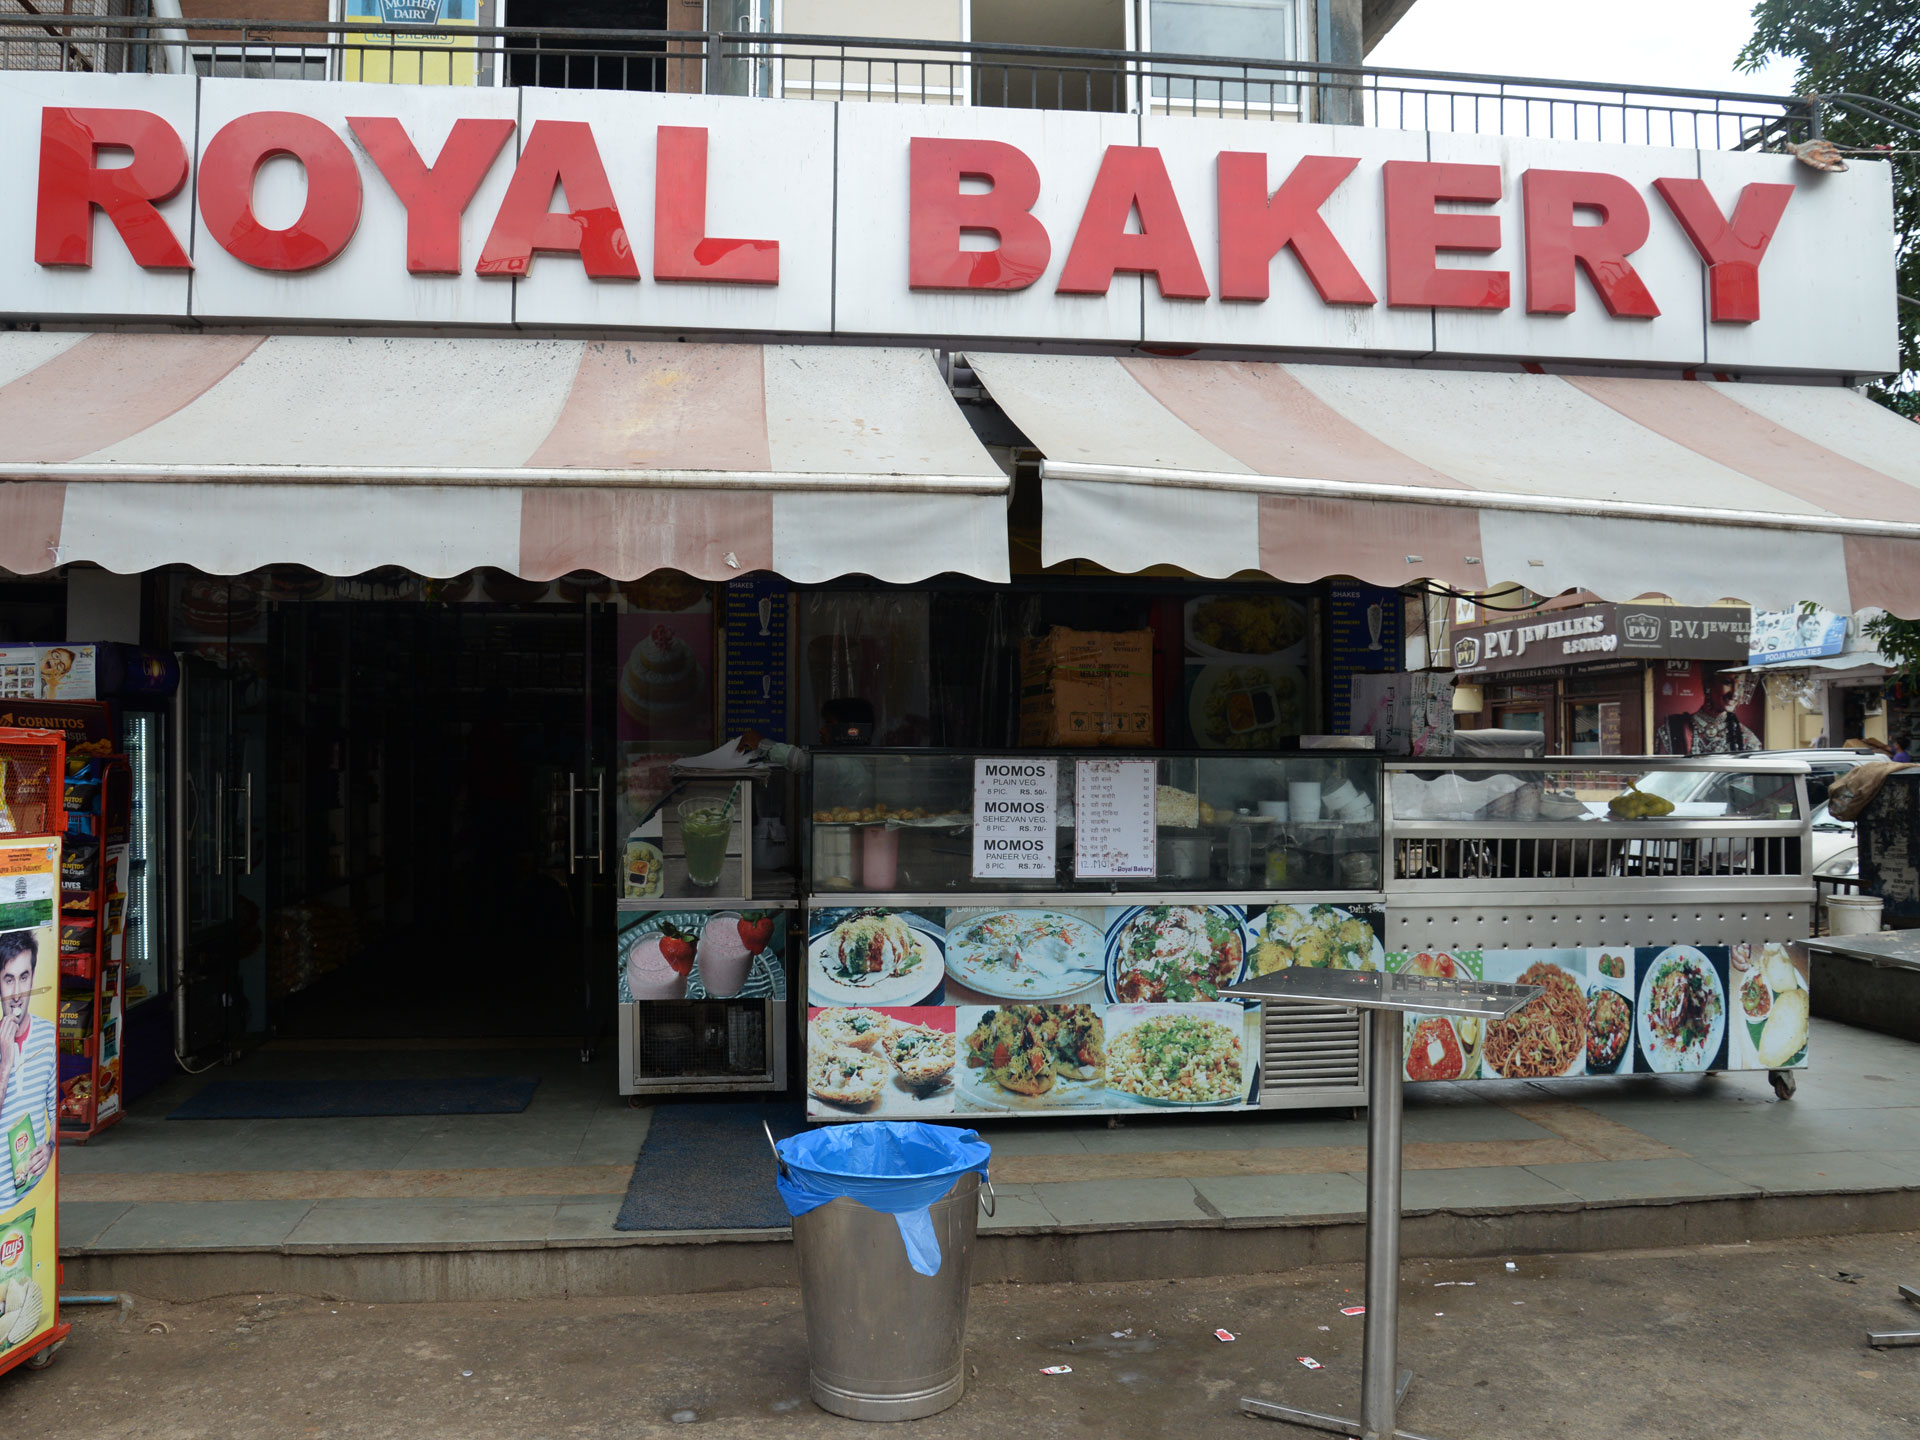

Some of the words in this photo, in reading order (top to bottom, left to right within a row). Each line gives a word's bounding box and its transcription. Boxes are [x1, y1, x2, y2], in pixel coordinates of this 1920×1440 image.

[385, 0, 436, 12] MOTHER
[394, 10, 428, 19] DAIRY
[35, 107, 780, 286] ROYAL
[910, 138, 1796, 323] BAKERY
[1516, 615, 1604, 656] JEWELLERS
[1629, 626, 1656, 638] PVJ
[1458, 649, 1475, 664] PVJ
[1765, 652, 1787, 662] POOJA
[1787, 647, 1822, 660] NOVALTIES
[1667, 660, 1689, 670] PVJ
[1386, 686, 1395, 745] FIESTA
[17, 715, 85, 729] CORNITOS
[985, 765, 1045, 777] MOMOS
[993, 778, 1017, 786] PLAIN
[985, 802, 1044, 813] MOMOS
[984, 840, 1044, 851] MOMOS
[986, 853, 1020, 861] PANEER
[1348, 904, 1366, 914] Dahi
[1, 1236, 25, 1260] Lay's
